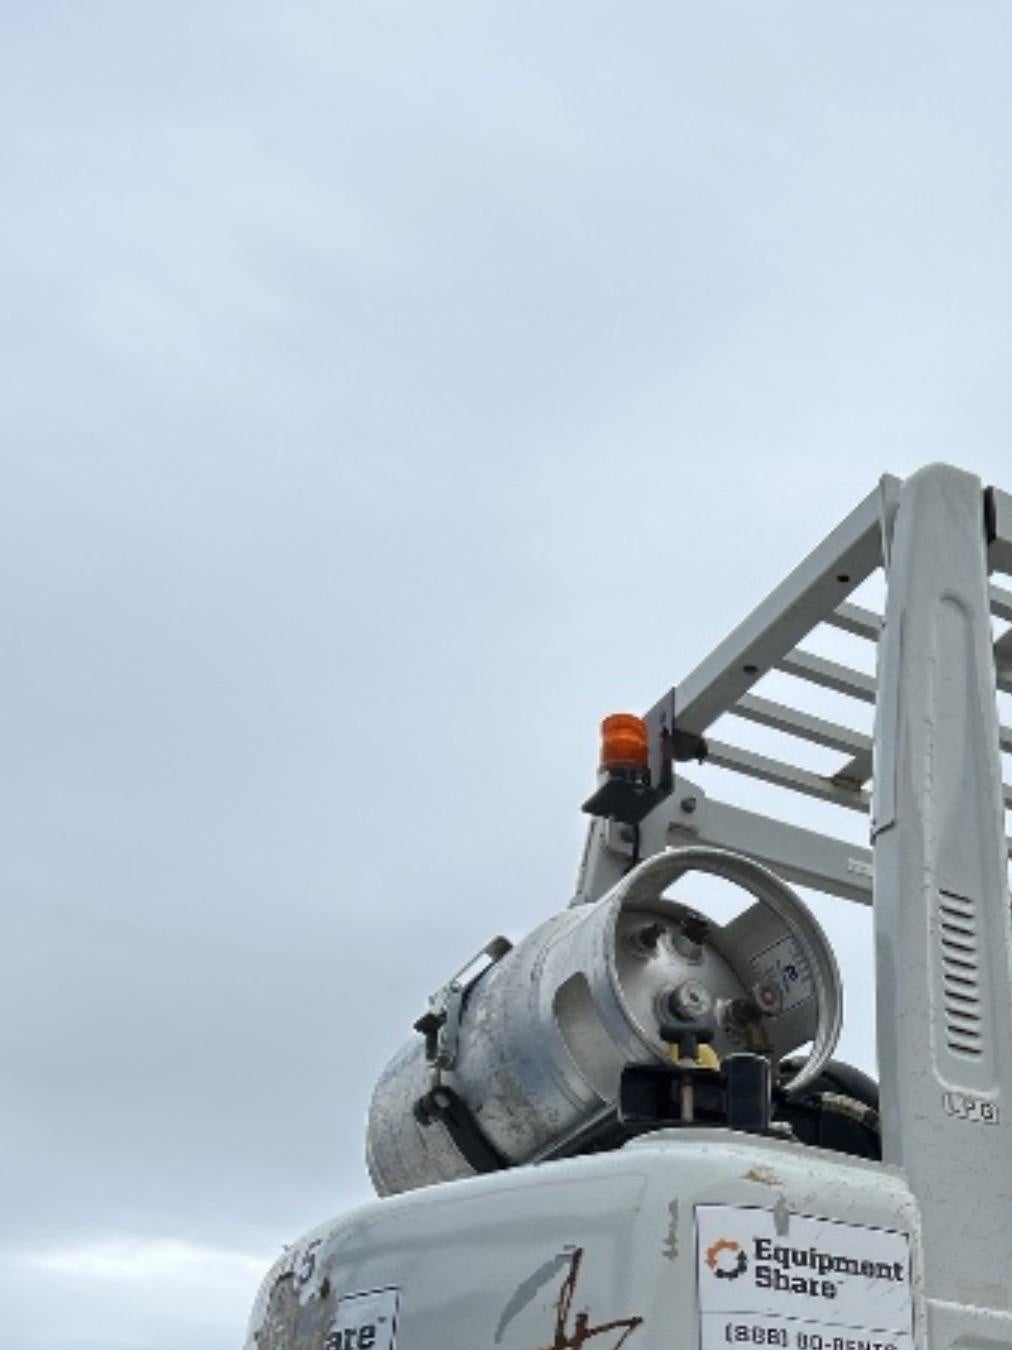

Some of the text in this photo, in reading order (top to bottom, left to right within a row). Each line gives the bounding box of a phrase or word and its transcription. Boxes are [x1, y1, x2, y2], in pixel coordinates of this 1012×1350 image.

[754, 1238, 904, 1281] Equipment
[755, 1265, 838, 1299] Share
[725, 1322, 788, 1347] (888)
